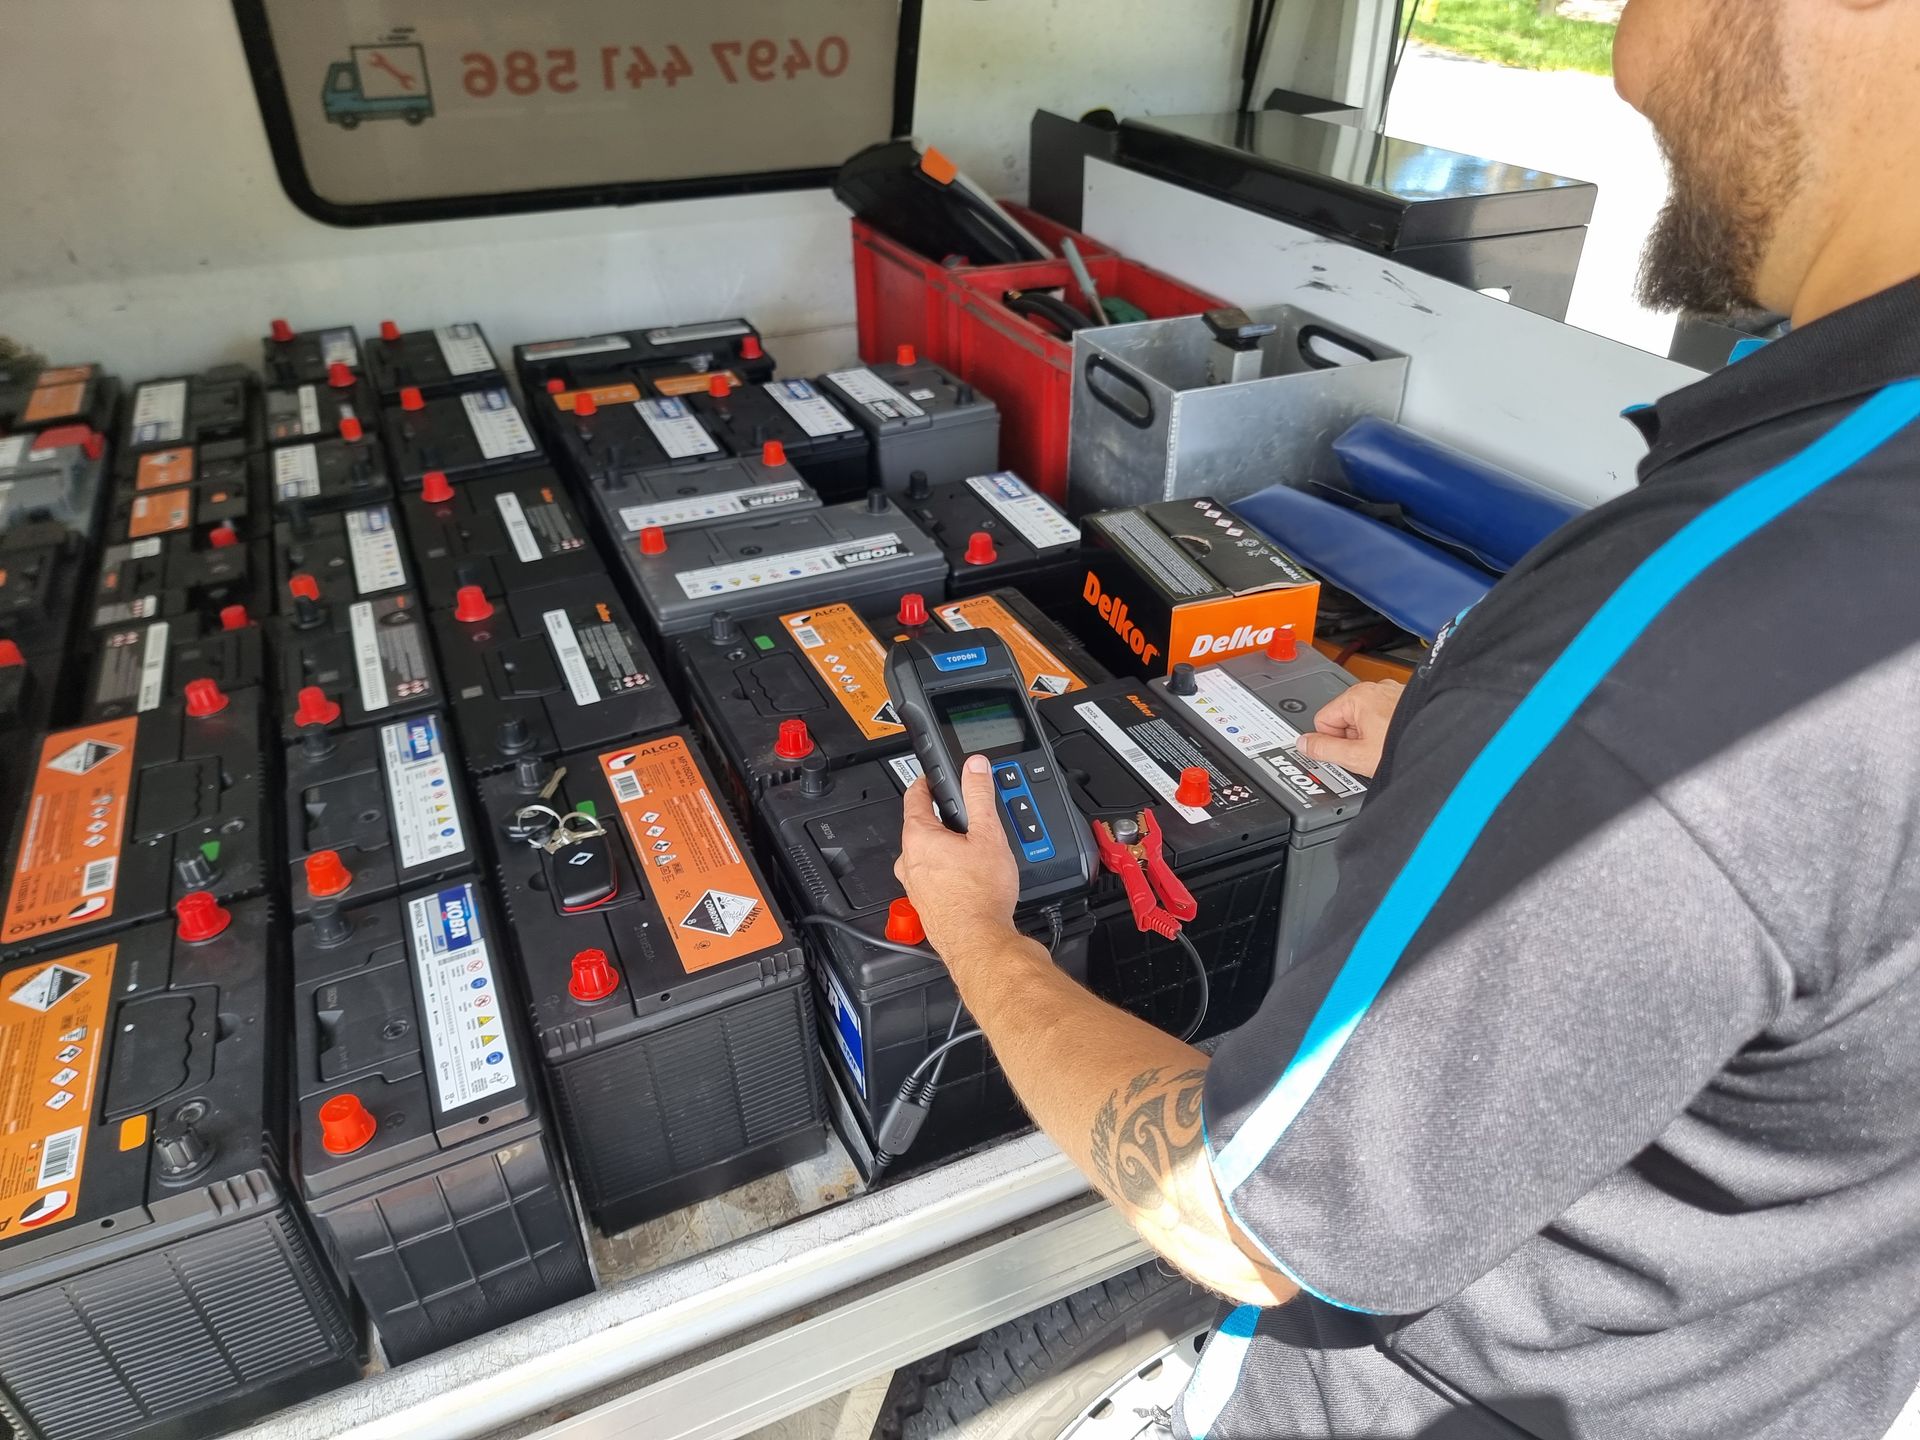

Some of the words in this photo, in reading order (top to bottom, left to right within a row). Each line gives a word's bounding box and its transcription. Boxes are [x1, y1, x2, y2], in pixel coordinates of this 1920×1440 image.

[844, 545, 898, 563] KOBA
[815, 607, 846, 617] ALCO
[963, 600, 990, 609] ALCO
[1082, 571, 1156, 666] Delkor
[1126, 695, 1156, 718] Delkor
[641, 742, 680, 757] ALCO
[1006, 772, 1017, 782] M
[1033, 766, 1046, 775] EXIT
[1268, 755, 1326, 795] KOBA
[9, 914, 62, 935] ALCO
[444, 900, 468, 939] KOBA
[686, 917, 697, 926] 8
[703, 899, 725, 932] CORROSIVE
[737, 907, 764, 934] UN2794
